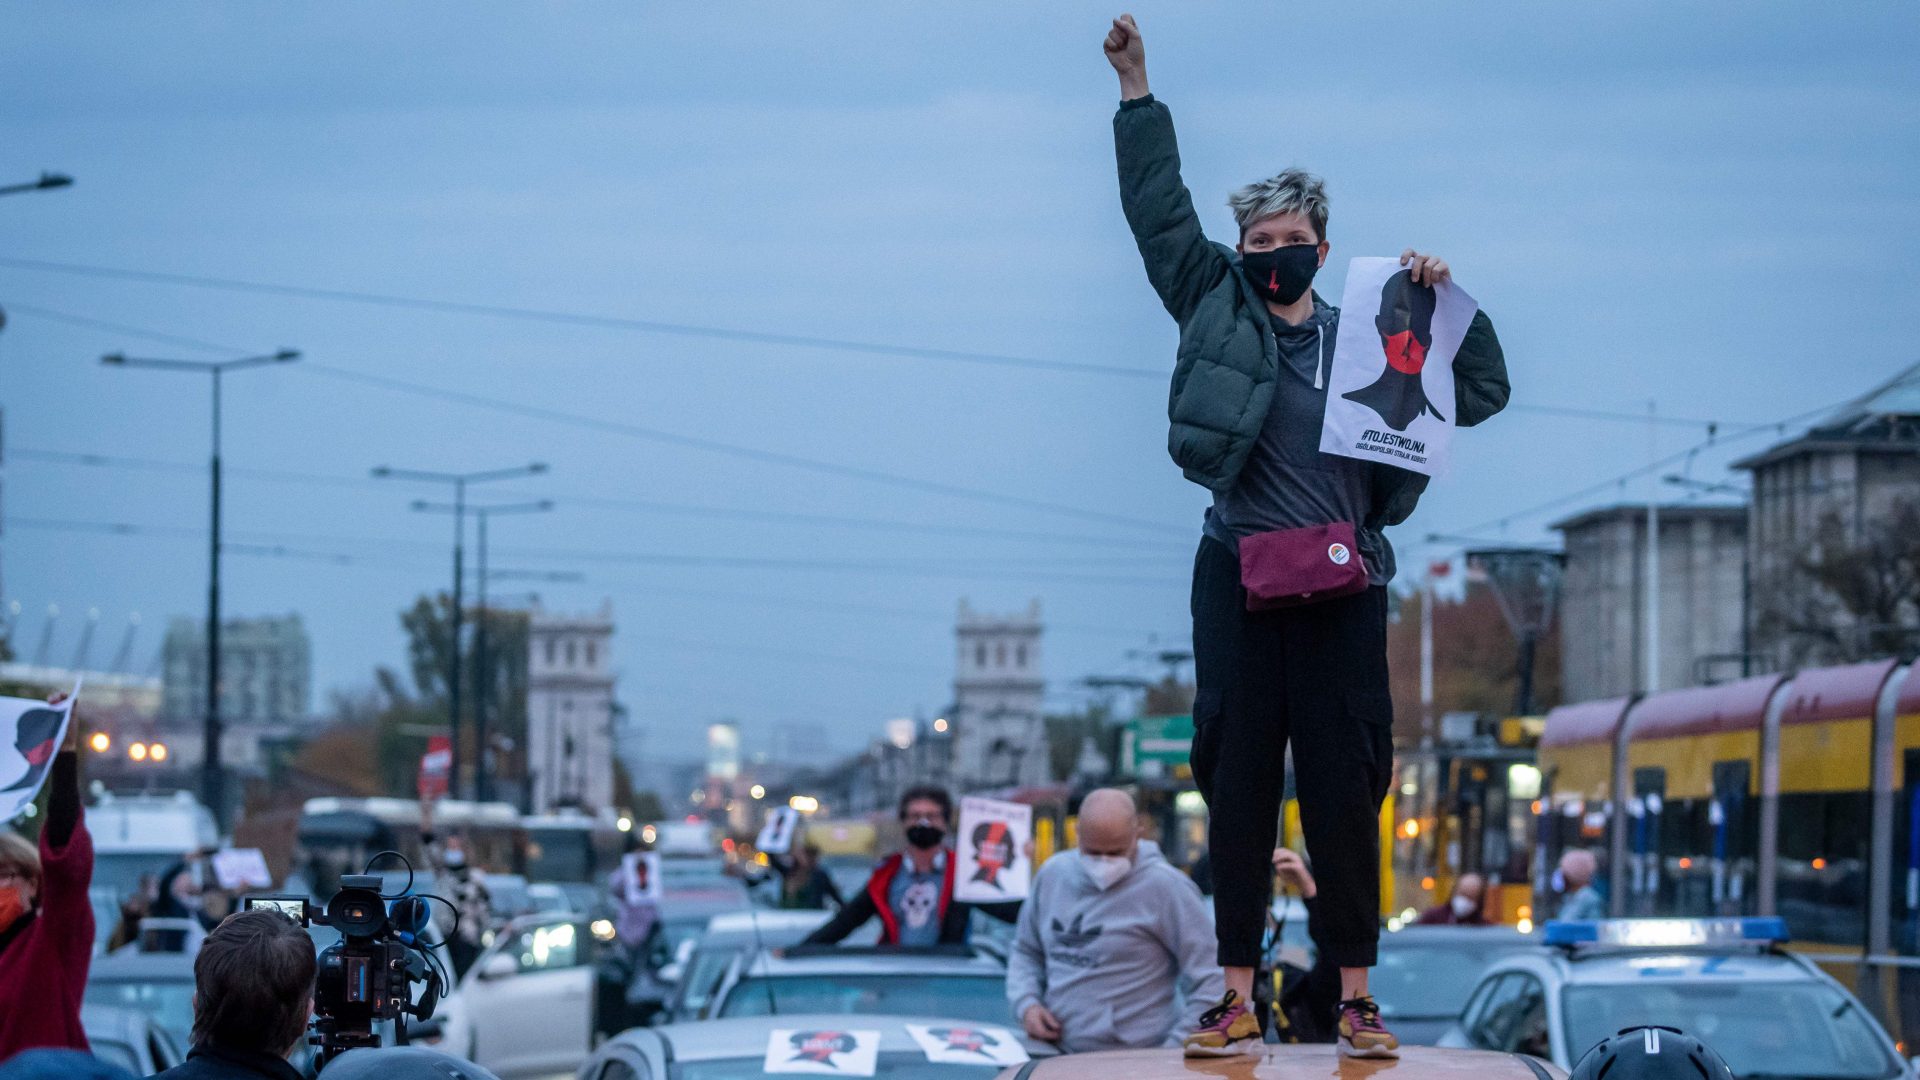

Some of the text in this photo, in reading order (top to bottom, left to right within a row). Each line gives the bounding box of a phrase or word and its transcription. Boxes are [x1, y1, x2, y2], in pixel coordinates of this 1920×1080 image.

[1355, 442, 1427, 464] OGÓLNOPOLSKI STRAJK KOBIET
[1361, 429, 1425, 454] #TOJESTWOJNA
